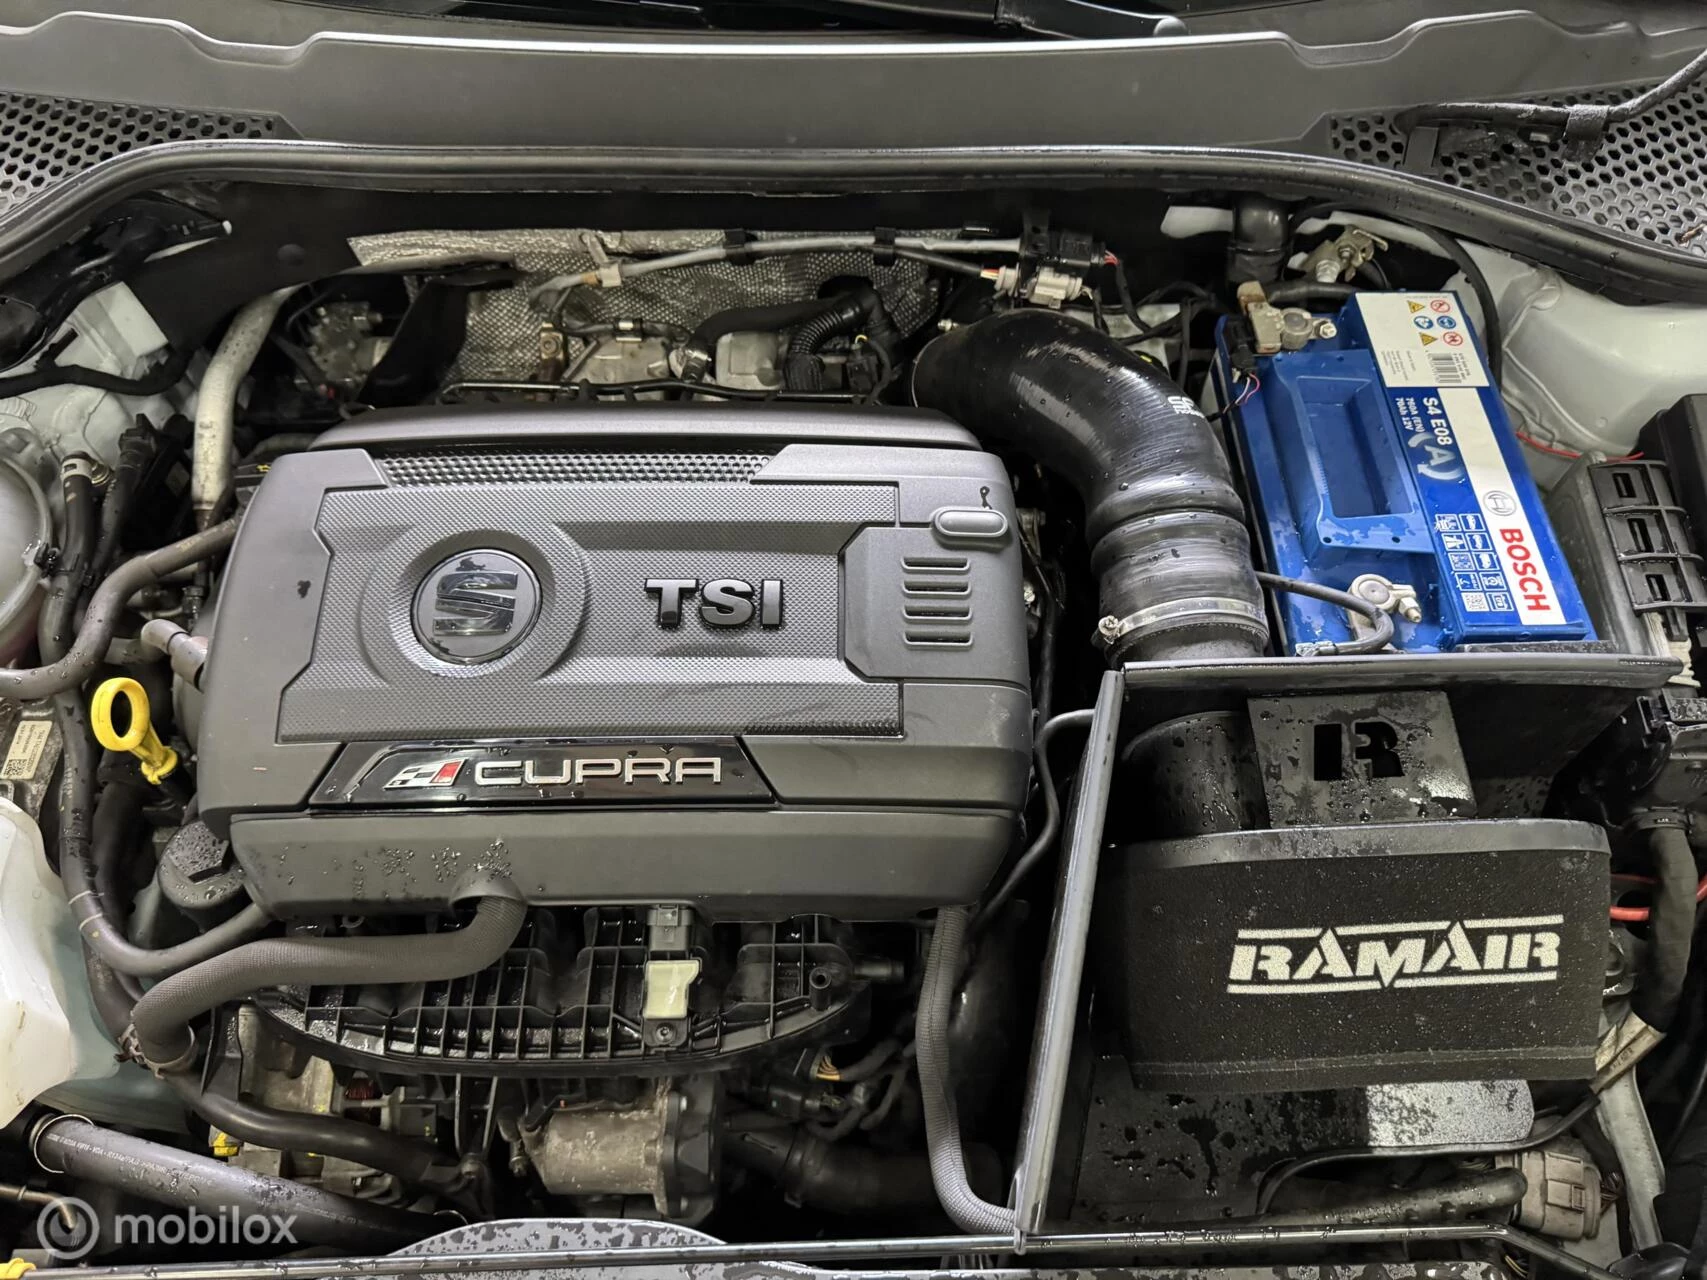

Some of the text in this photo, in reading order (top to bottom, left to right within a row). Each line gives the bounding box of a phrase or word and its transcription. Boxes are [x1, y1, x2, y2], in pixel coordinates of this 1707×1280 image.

[1423, 397, 1442, 415] S4
[1401, 417, 1414, 431] 12V
[1430, 418, 1453, 446] E08
[1499, 528, 1551, 611] BOSCH
[644, 577, 784, 630] TSI
[474, 756, 722, 785] CUPRA
[1228, 920, 1561, 989] RAMAIR
